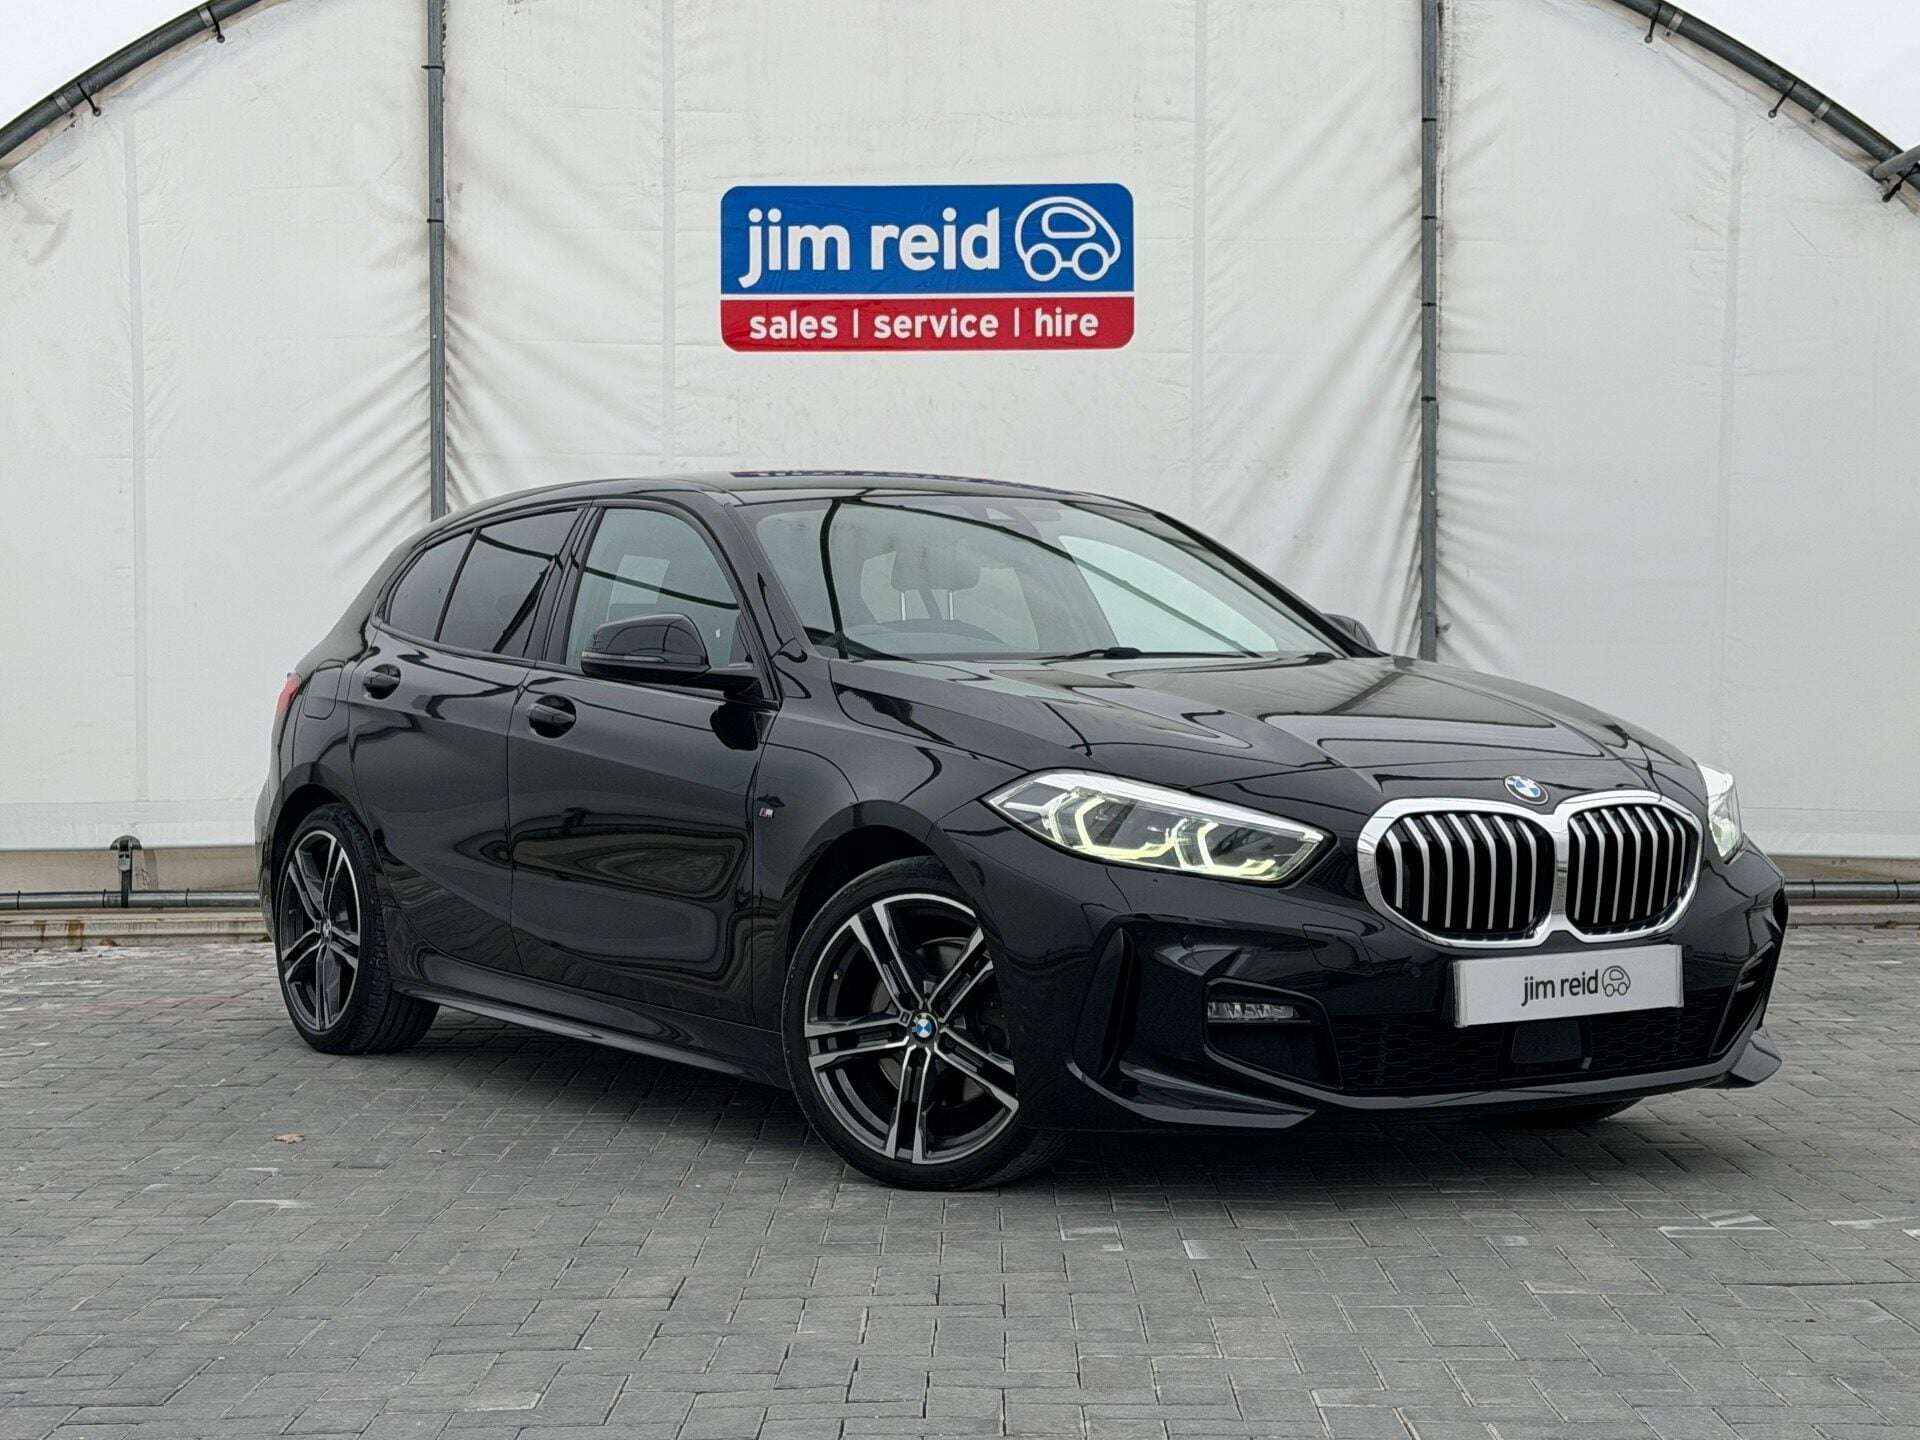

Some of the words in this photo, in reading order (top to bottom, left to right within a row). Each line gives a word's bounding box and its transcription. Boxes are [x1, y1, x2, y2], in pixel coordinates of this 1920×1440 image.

[738, 208, 850, 289] jim
[870, 207, 1000, 271] reid
[749, 309, 838, 340] sales
[873, 307, 999, 339] service
[1034, 306, 1099, 337] hire
[1521, 976, 1556, 1007] jim
[1560, 969, 1599, 997] reid
